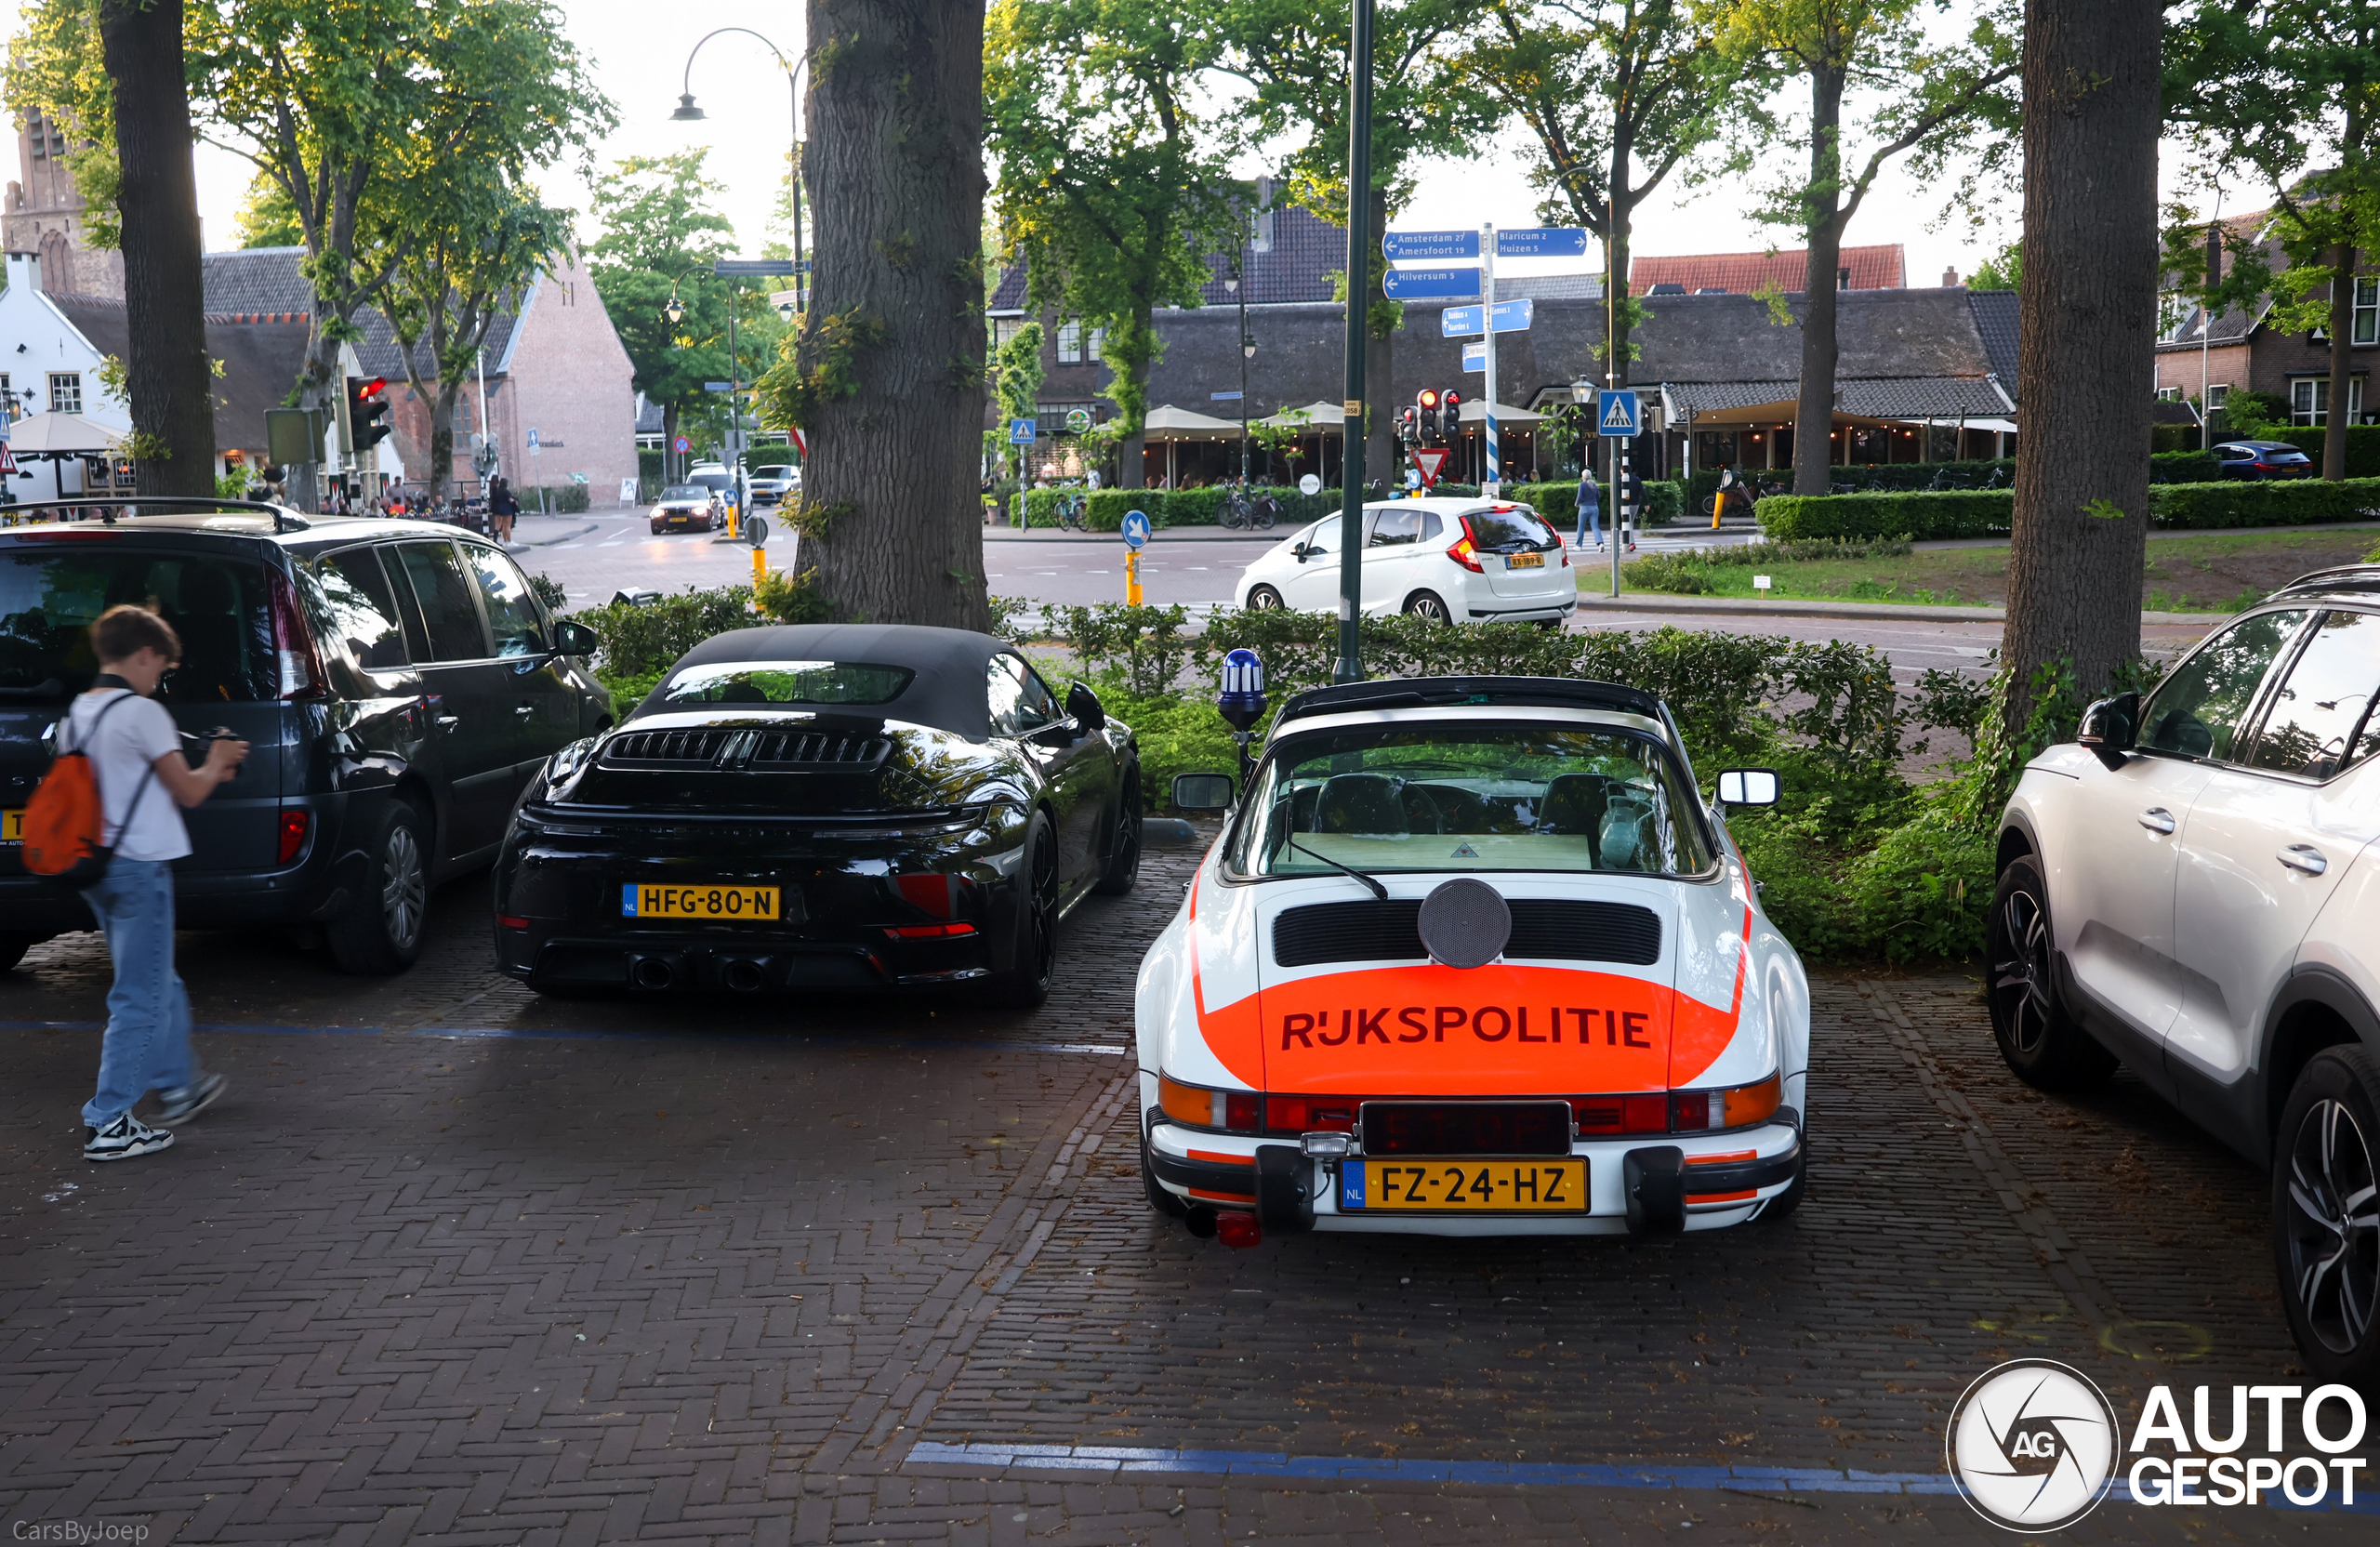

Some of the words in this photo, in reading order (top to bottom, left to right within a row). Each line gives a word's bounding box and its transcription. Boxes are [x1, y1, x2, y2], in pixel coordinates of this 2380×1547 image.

[1397, 233, 1452, 244] Amsterdam
[1455, 233, 1465, 242] 27
[1499, 232, 1540, 241] Blaricum
[1397, 246, 1452, 256] Amersfoort
[1499, 245, 1531, 253] Huizen
[1398, 272, 1447, 281] Hilversum
[1448, 323, 1466, 331] Naarden
[1512, 557, 1541, 565] RX-189-R
[625, 903, 636, 911] NL
[644, 889, 771, 915] HFG-80-N
[1346, 1189, 1362, 1200] NL
[1382, 1167, 1567, 1202] FZ-24-HZ
